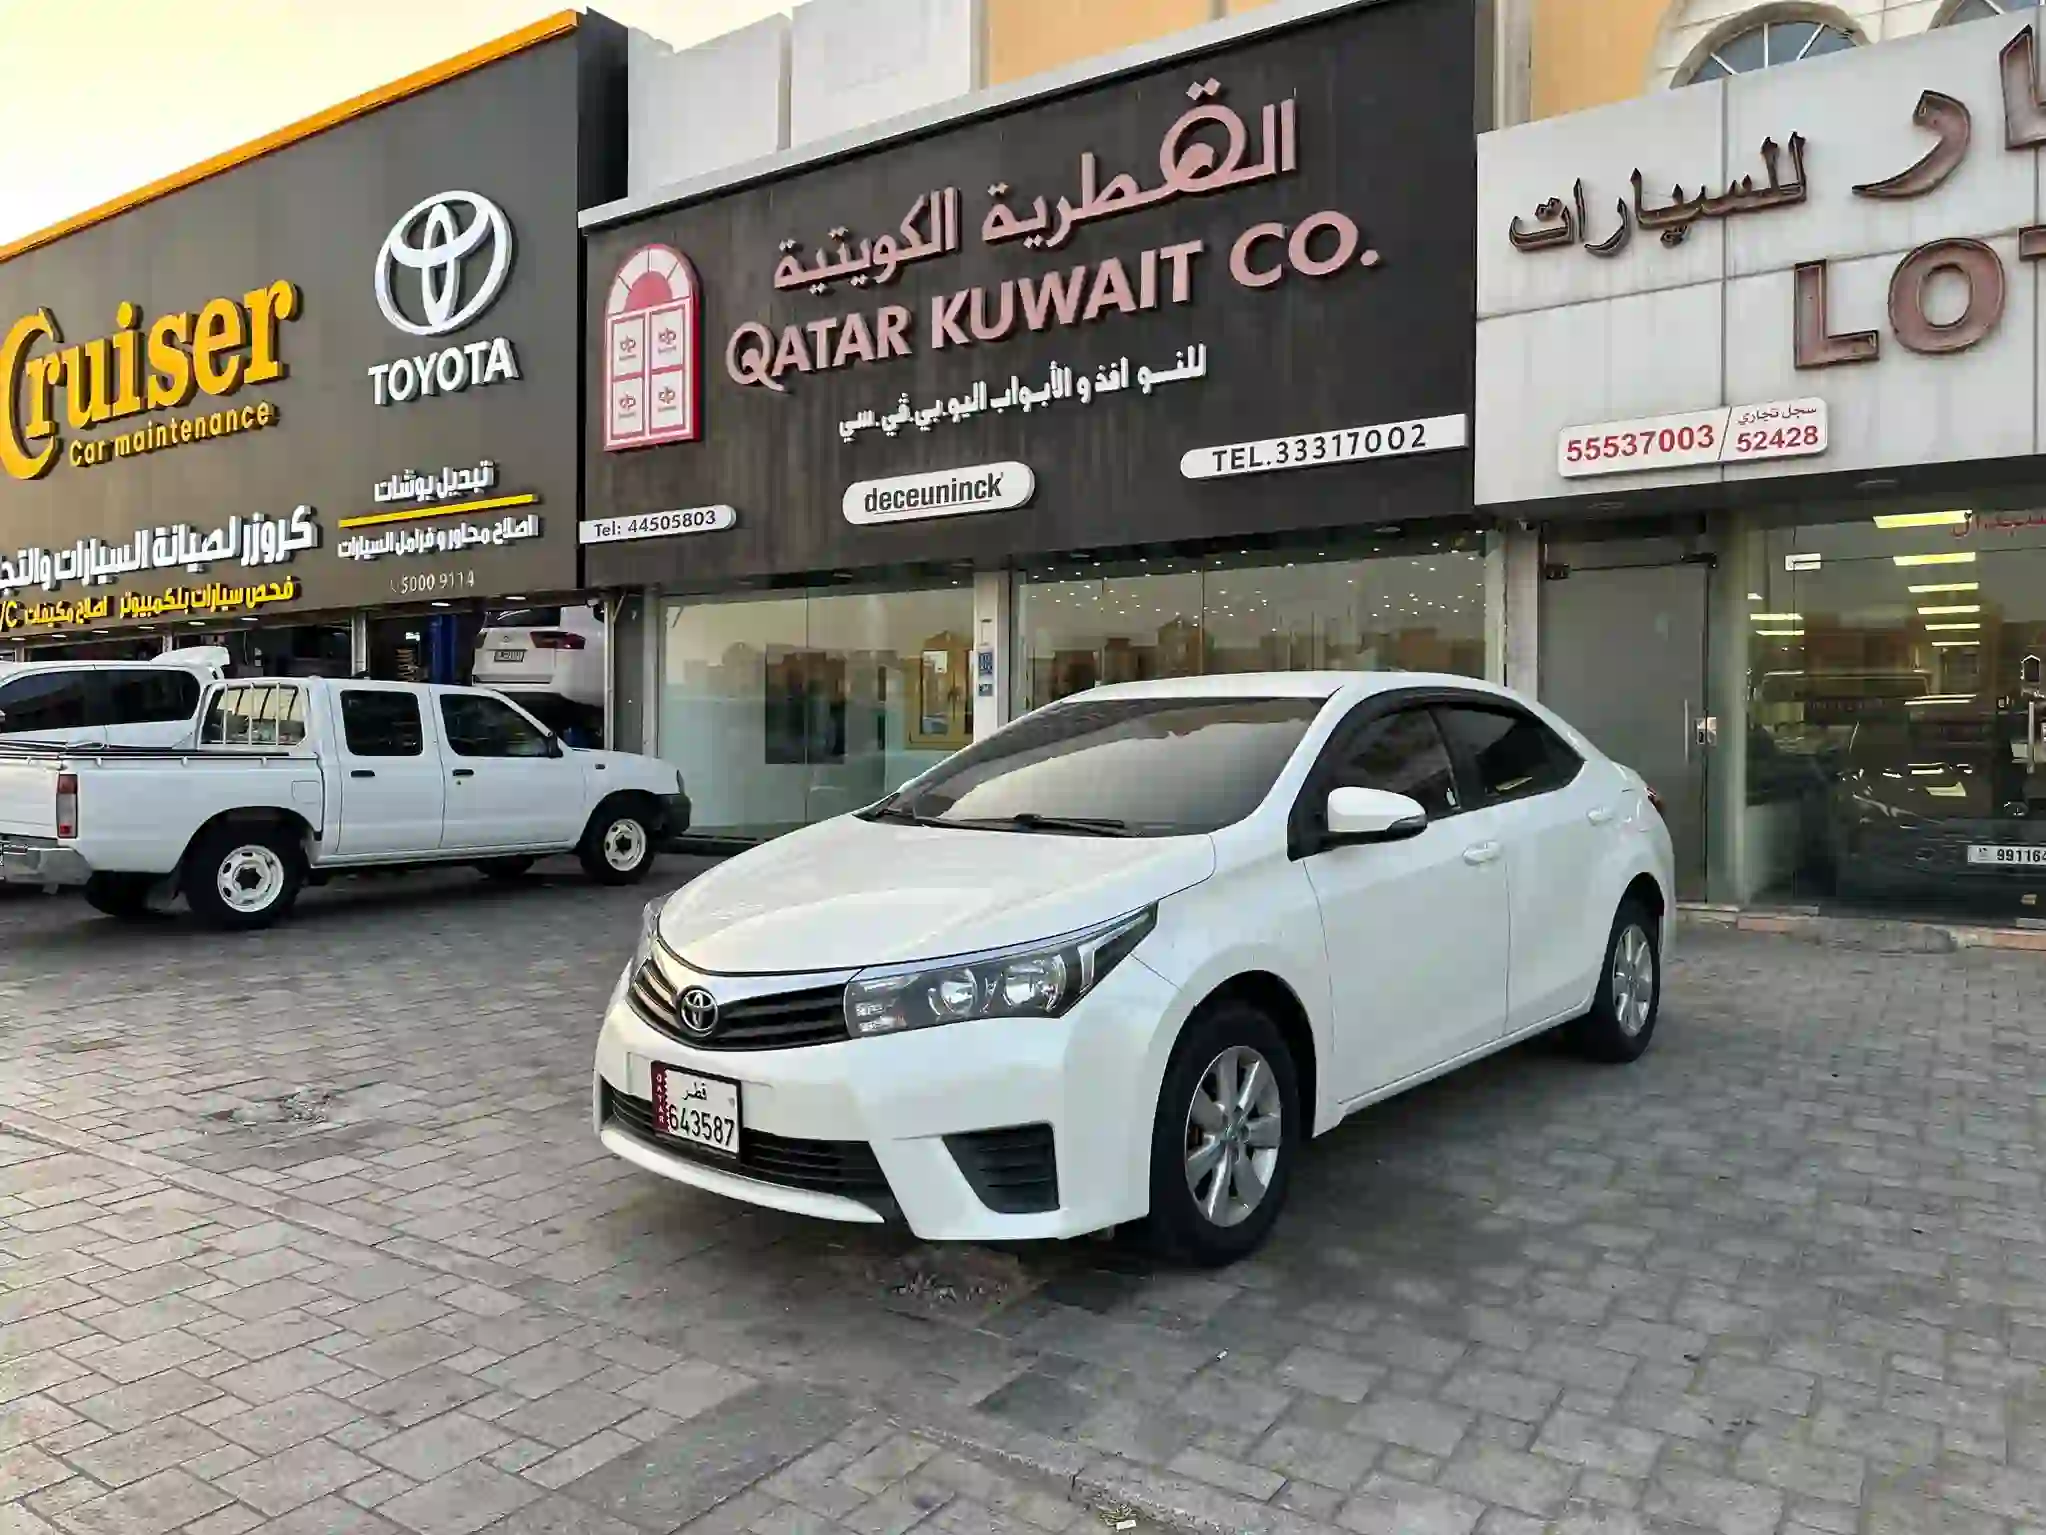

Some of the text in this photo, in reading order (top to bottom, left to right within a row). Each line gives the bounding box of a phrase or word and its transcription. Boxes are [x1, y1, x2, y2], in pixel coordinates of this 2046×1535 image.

[773, 77, 1297, 295] القطرية الكويتية
[1508, 131, 1807, 258] للسيارات
[725, 209, 1381, 393] QATAR KUWAIT CO.
[0, 279, 299, 479] Cruiser
[368, 336, 521, 406] TOYOTA
[69, 401, 271, 467] Car maintenance
[1736, 424, 1819, 453] 52428
[1738, 404, 1817, 426] سجل تجاري
[1566, 425, 1715, 462] 55537003
[864, 472, 1003, 512] deceuninck
[594, 510, 717, 537] Tel: 44505803
[0, 547, 54, 596] والتج
[54, 529, 149, 586] السيارات
[656, 1073, 665, 1124] QATAR
[681, 1081, 708, 1100] قطر
[668, 1103, 736, 1147] 643587
